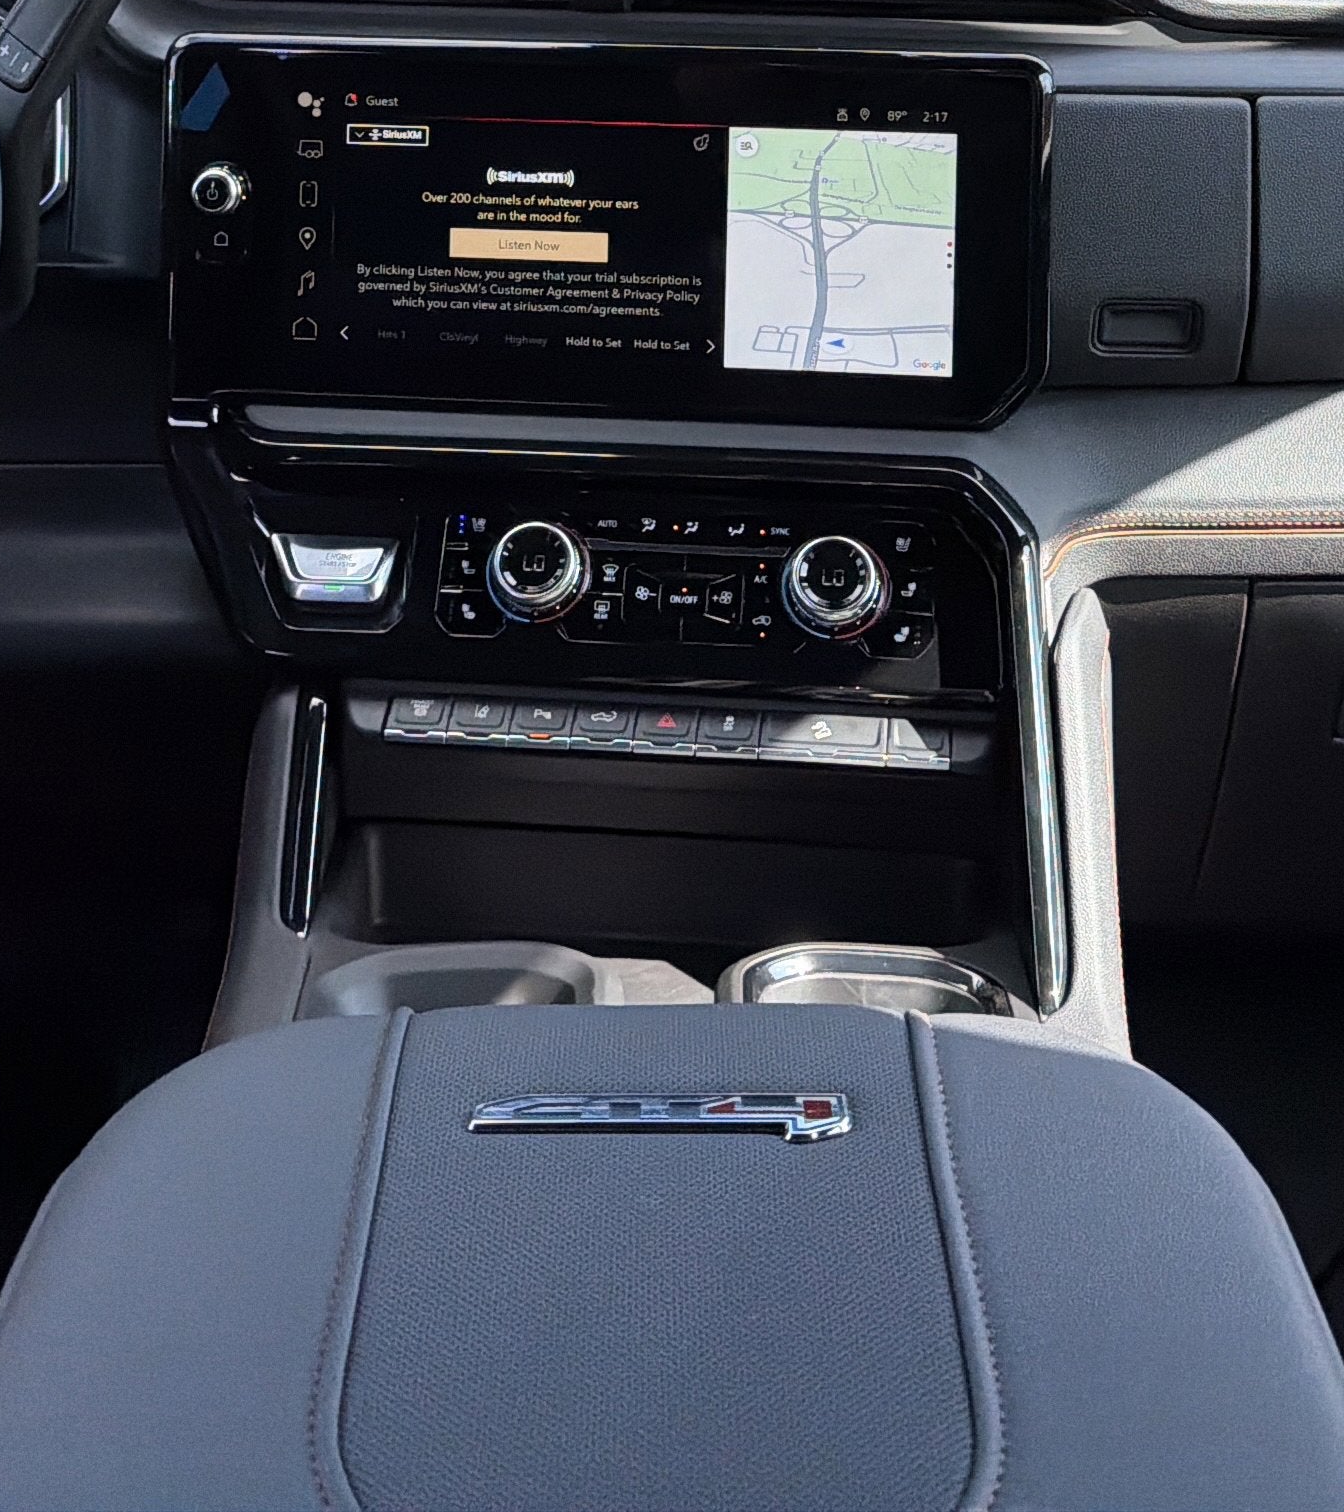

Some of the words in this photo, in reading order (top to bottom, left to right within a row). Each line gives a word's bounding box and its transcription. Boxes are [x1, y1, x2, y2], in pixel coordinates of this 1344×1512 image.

[365, 95, 399, 107] Guest
[422, 192, 447, 203] Over
[450, 193, 471, 203] 200
[473, 194, 521, 205] channels
[524, 194, 536, 205] of
[537, 196, 586, 207] whatever
[588, 199, 613, 210] your
[615, 200, 639, 209] ears
[477, 212, 494, 220] are
[497, 210, 507, 221] in
[509, 211, 527, 221] the
[529, 212, 561, 222] mood
[564, 212, 582, 223] for.
[498, 239, 532, 250] Listen
[534, 240, 560, 251] Now
[356, 264, 371, 277] By
[373, 265, 415, 278] clicking
[418, 266, 451, 277] Listen
[454, 267, 482, 279] Now,
[484, 271, 505, 281] you
[508, 271, 540, 281] agree
[542, 270, 565, 281] that
[566, 273, 592, 284] your
[595, 272, 617, 283] trial
[619, 274, 689, 286] subscription
[693, 276, 702, 286] is
[358, 281, 410, 293] governed
[413, 281, 426, 294] by
[429, 282, 487, 294] SiriusXM's
[490, 284, 544, 296] Customer
[546, 286, 609, 300] Agreement
[611, 289, 621, 299] &
[623, 289, 663, 303] Privacy
[666, 291, 700, 305] Policy
[392, 297, 425, 308] which
[427, 300, 448, 310] you
[450, 301, 470, 310] can
[472, 300, 498, 310] view
[500, 302, 512, 311] at
[565, 337, 590, 347] Hold
[592, 338, 603, 347] to
[605, 338, 622, 348] Set
[633, 339, 658, 349] Hold
[660, 340, 671, 350] to
[673, 341, 691, 351] Set
[913, 359, 947, 370] Google
[597, 519, 618, 528] AUTO
[770, 527, 791, 536] SYNC
[754, 575, 768, 584] A/C
[669, 594, 698, 605] ON/OFF
